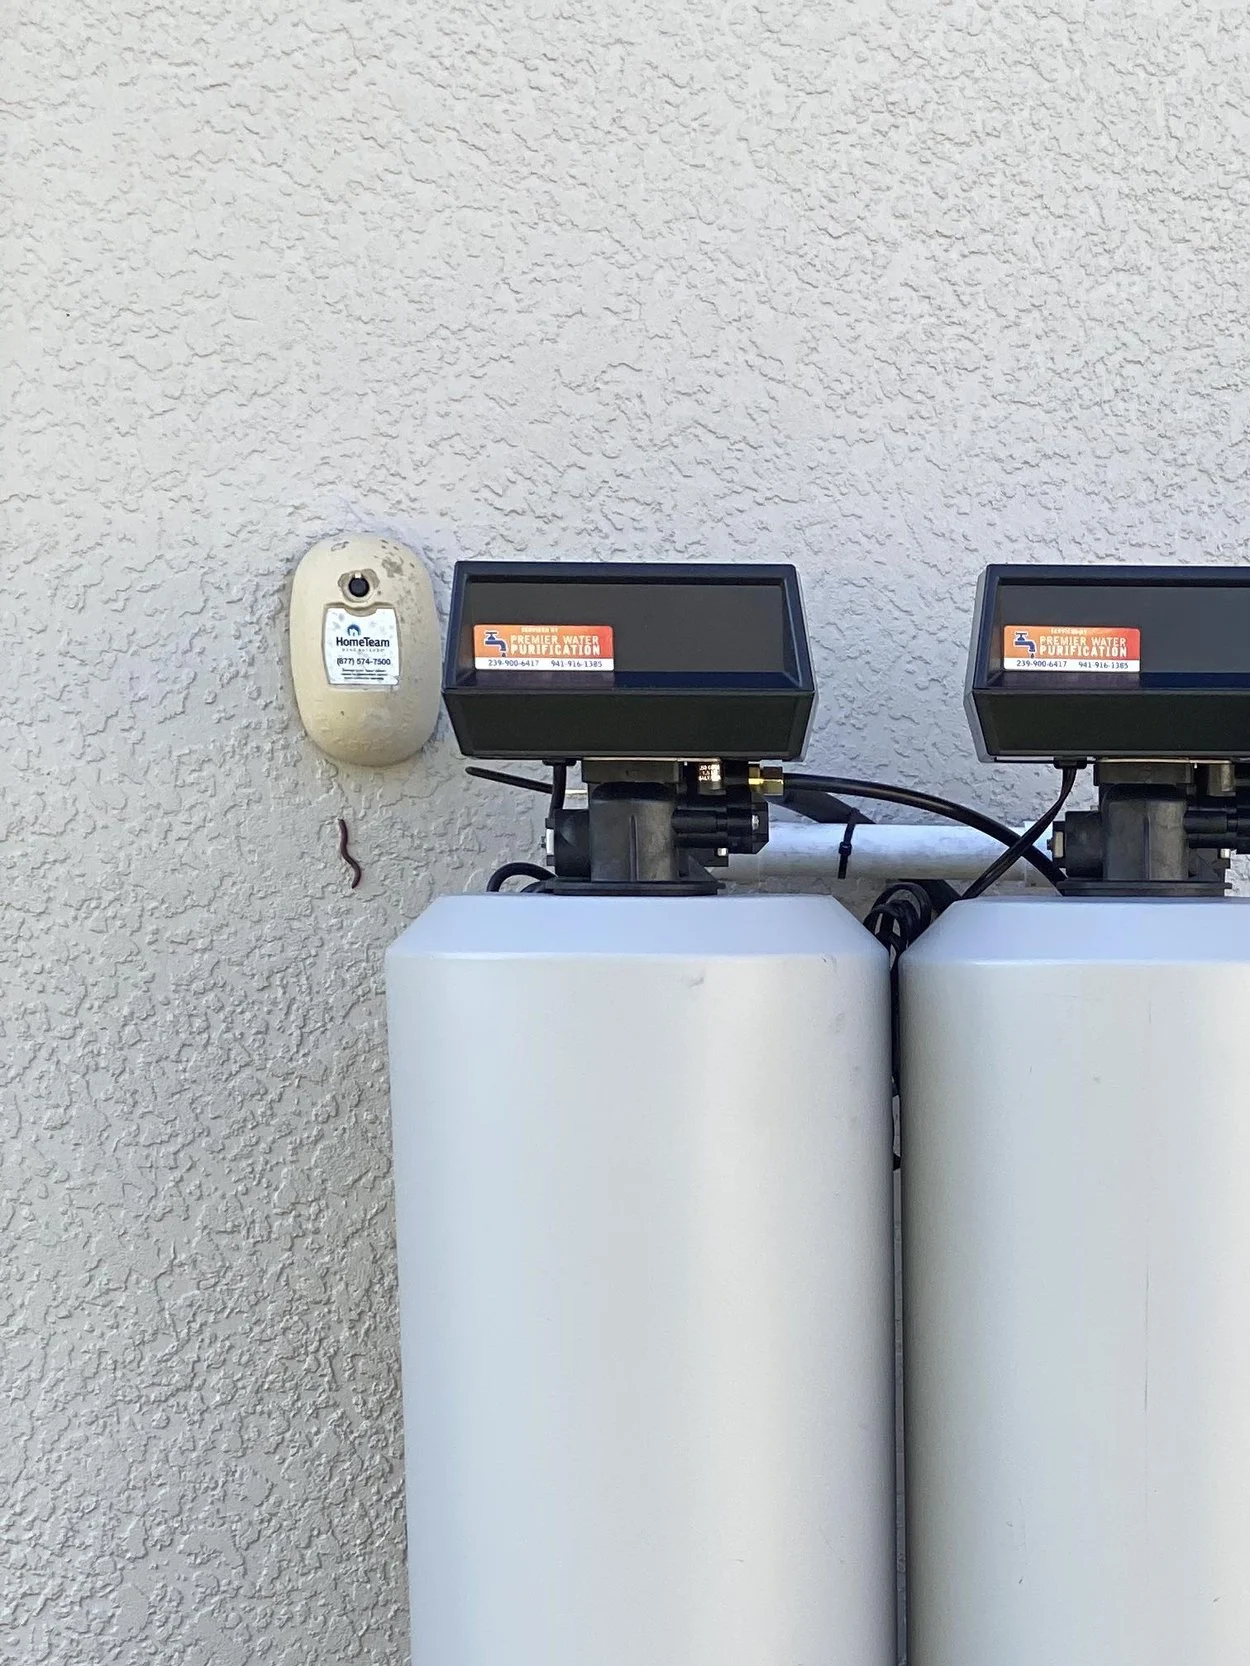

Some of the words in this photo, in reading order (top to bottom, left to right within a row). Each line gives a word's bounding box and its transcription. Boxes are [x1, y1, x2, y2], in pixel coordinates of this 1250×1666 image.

[336, 636, 390, 647] HomeTeam
[510, 635, 558, 645] PREMIER
[563, 635, 599, 645] WATER
[1039, 636, 1086, 646] PREMIER
[1091, 637, 1127, 647] WATER
[510, 644, 600, 656] PURIFICATION
[1039, 645, 1127, 657] PURIFICATION
[336, 658, 355, 667] (877)
[356, 658, 391, 666] 574-7500
[488, 659, 539, 667] 239-900-6417
[550, 660, 603, 668] 941-916-1385
[1016, 660, 1067, 668] 239-900-6417
[1078, 661, 1129, 669] 941-916-1385
